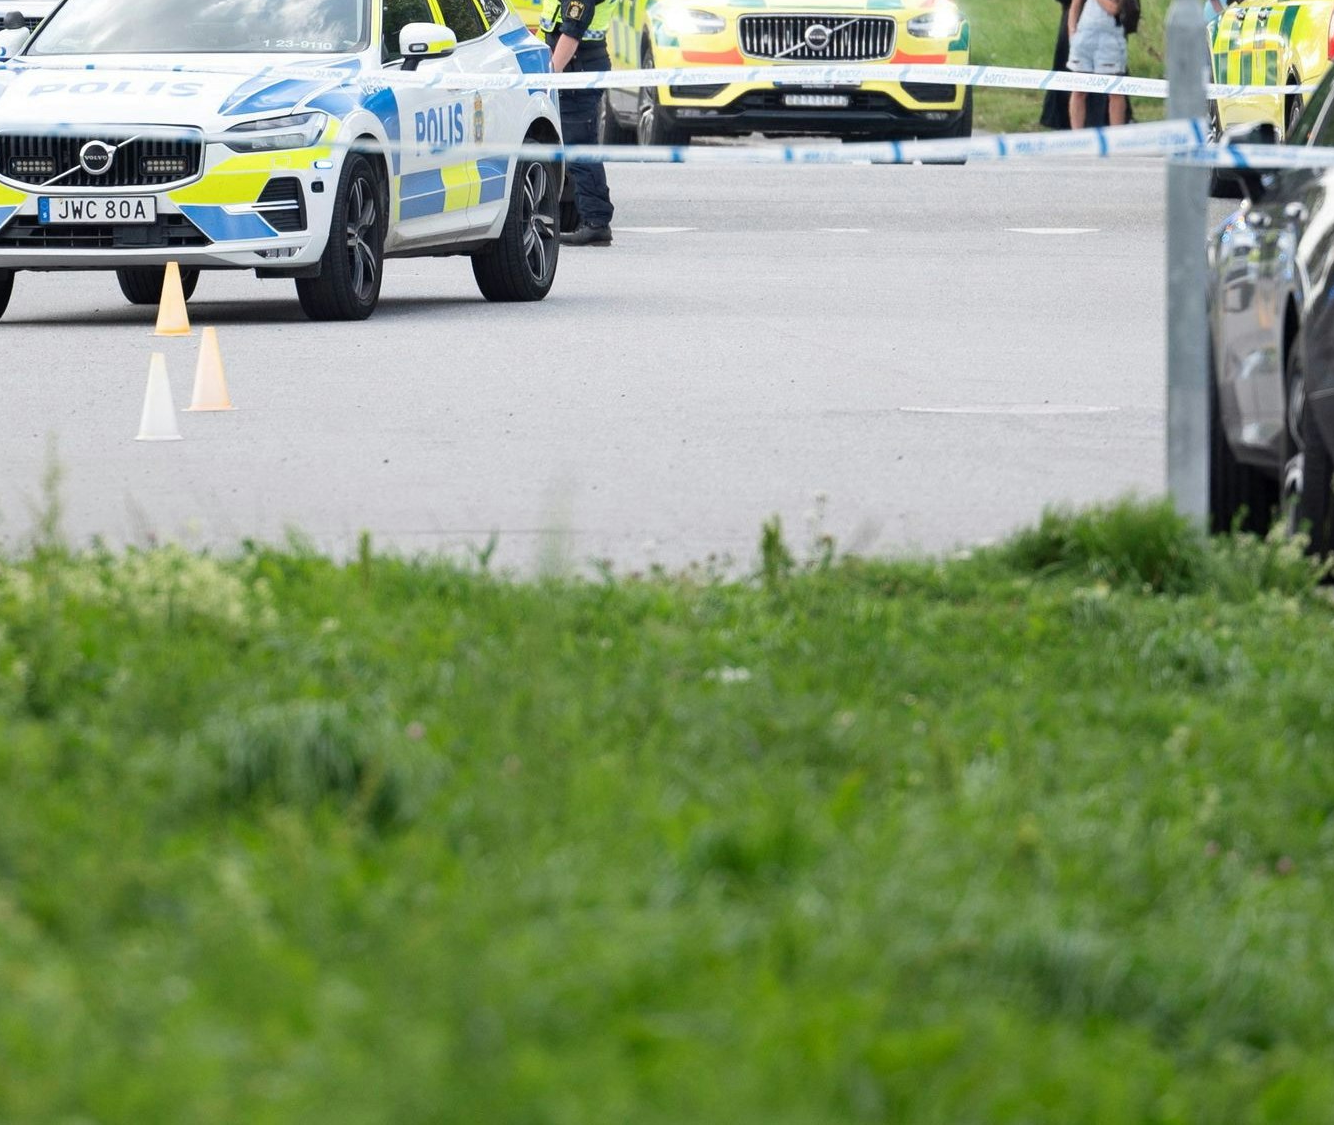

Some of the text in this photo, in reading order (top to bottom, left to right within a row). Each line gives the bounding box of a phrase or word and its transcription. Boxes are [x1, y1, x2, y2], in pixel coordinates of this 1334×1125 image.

[28, 81, 204, 98] POLIS
[415, 103, 464, 146] POLIS
[58, 200, 146, 220] JWC 80A
